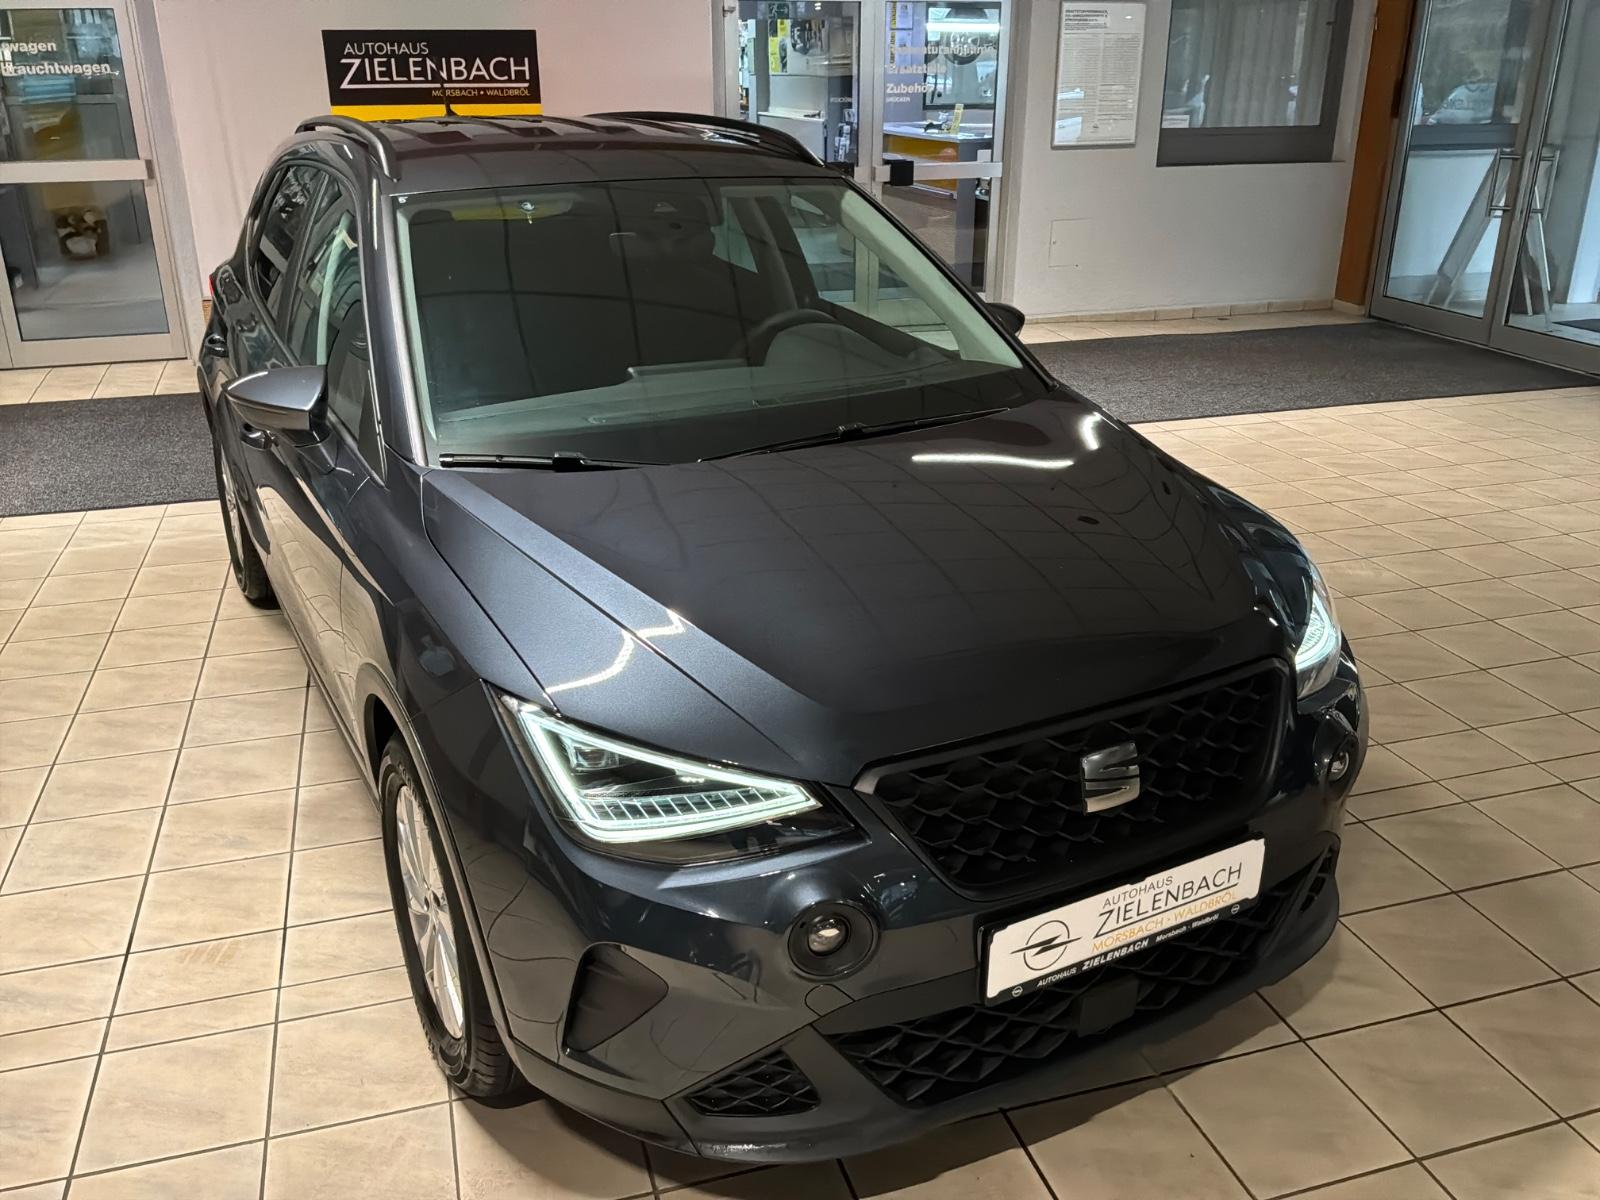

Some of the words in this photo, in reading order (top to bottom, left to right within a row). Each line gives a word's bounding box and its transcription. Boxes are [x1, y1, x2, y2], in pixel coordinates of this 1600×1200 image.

[1, 41, 57, 54] wagen
[344, 42, 429, 55] AUTOHAUS
[339, 57, 531, 89] ZIELENBACH
[486, 87, 530, 97] WALDBRÖL
[1093, 862, 1243, 939] ZIELENBACH
[1102, 876, 1173, 909] AUTOHAUS
[1090, 917, 1165, 953] MORSBACH
[1174, 890, 1238, 922] WALDBRÖL
[1037, 967, 1078, 988] AUTOHAUS
[1081, 938, 1150, 972] ZIELENBACH
